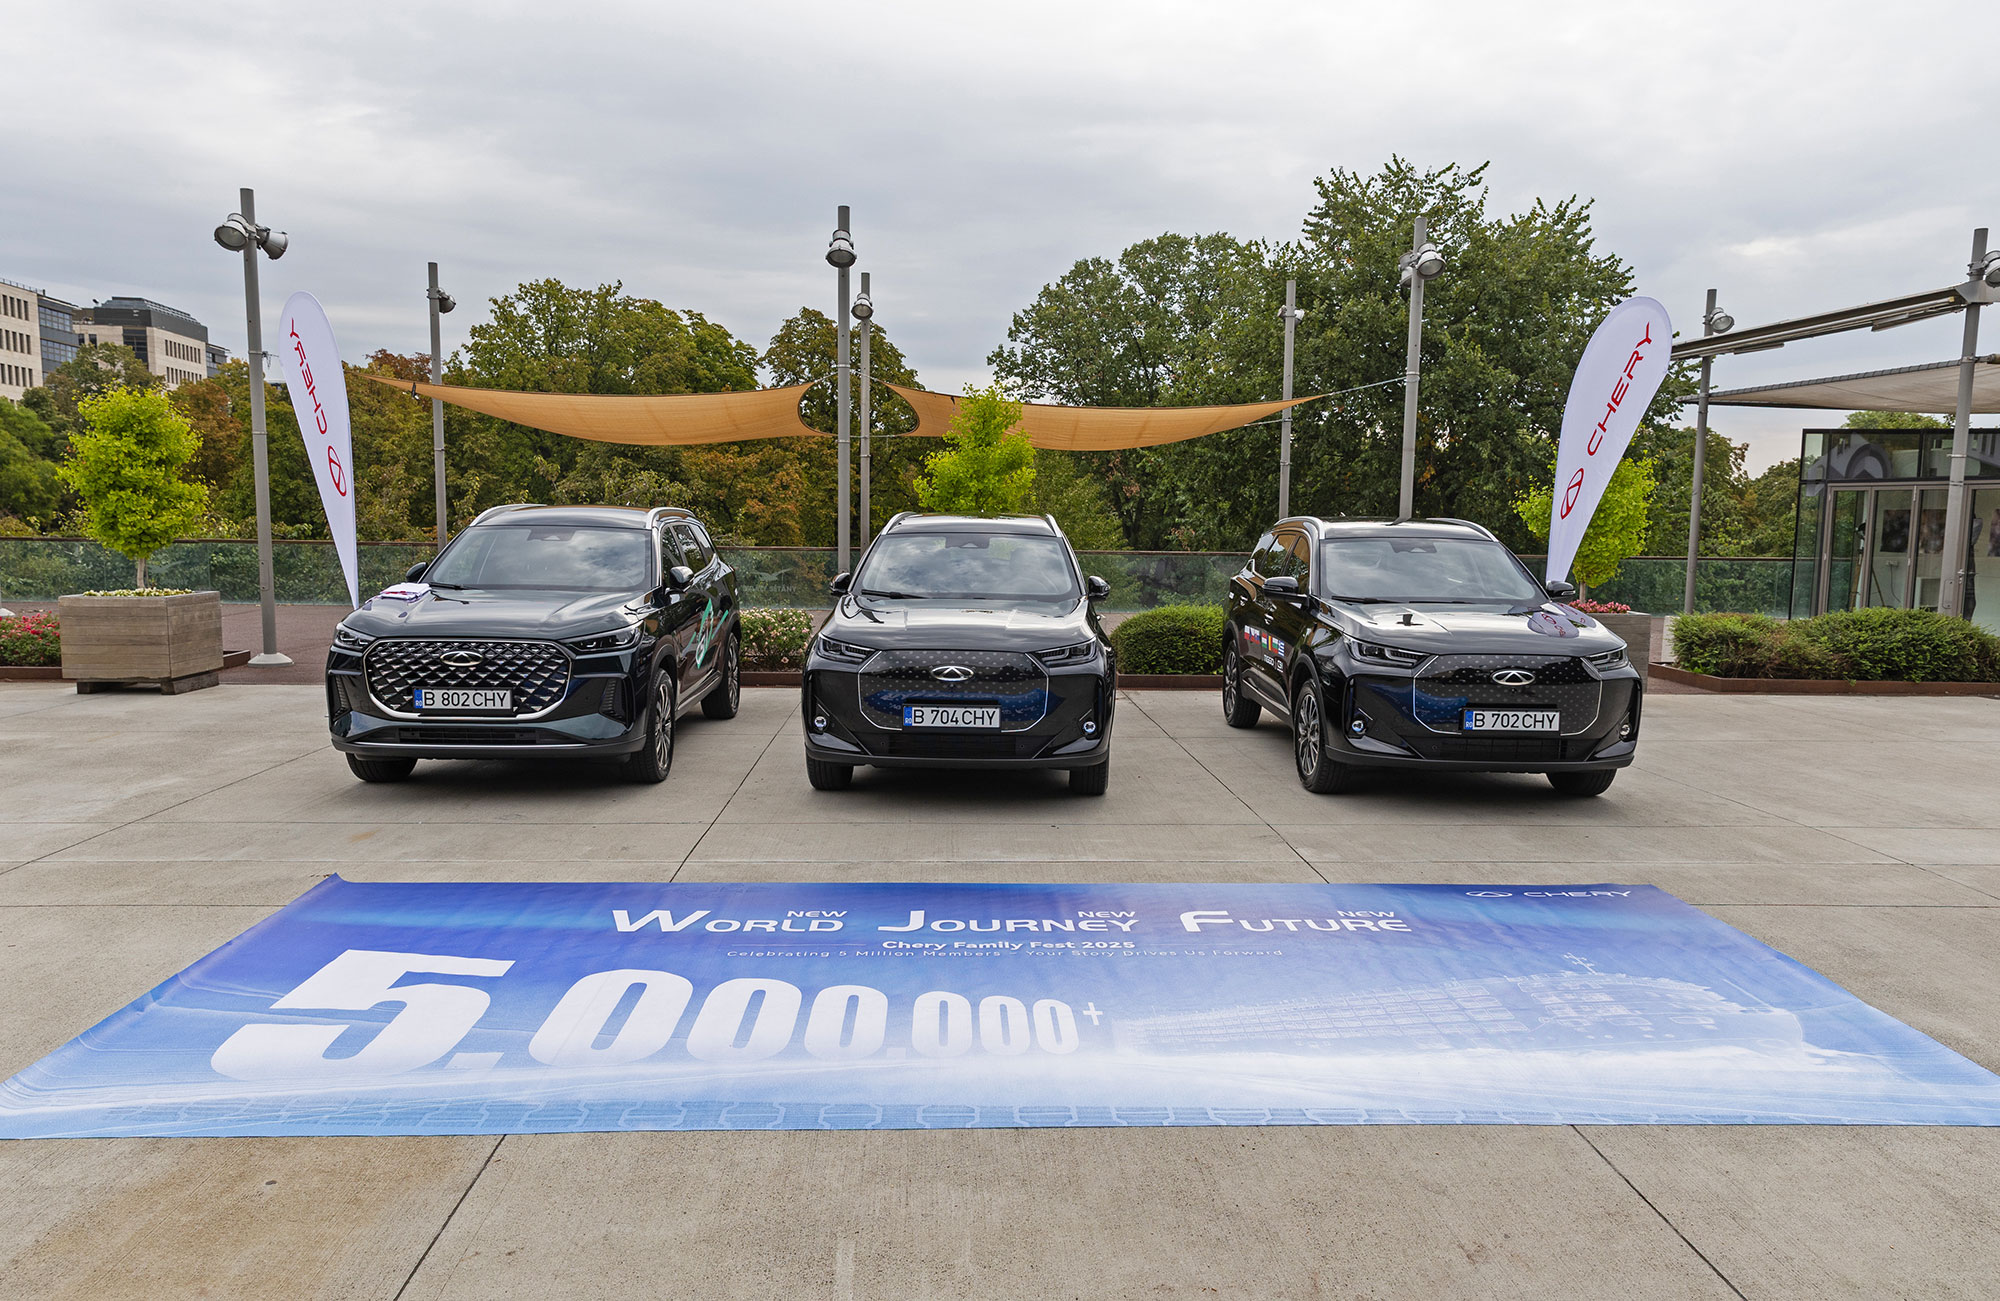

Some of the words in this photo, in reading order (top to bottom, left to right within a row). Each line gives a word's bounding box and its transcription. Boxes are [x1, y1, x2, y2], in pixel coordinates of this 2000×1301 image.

[1587, 321, 1652, 456] CHERY
[424, 692, 435, 706] B
[914, 710, 925, 724] B
[1475, 713, 1485, 728] B
[1523, 890, 1631, 898] CHERY
[787, 910, 848, 918] NEW
[1336, 910, 1395, 918] NEW
[612, 910, 845, 933] WORLD
[878, 910, 1140, 932] JOURNEY
[1180, 910, 1413, 932] FUTURE
[882, 941, 947, 951] Chery
[953, 941, 1023, 951] Family
[1030, 941, 1076, 949] Fest
[1081, 941, 1136, 949] 2025
